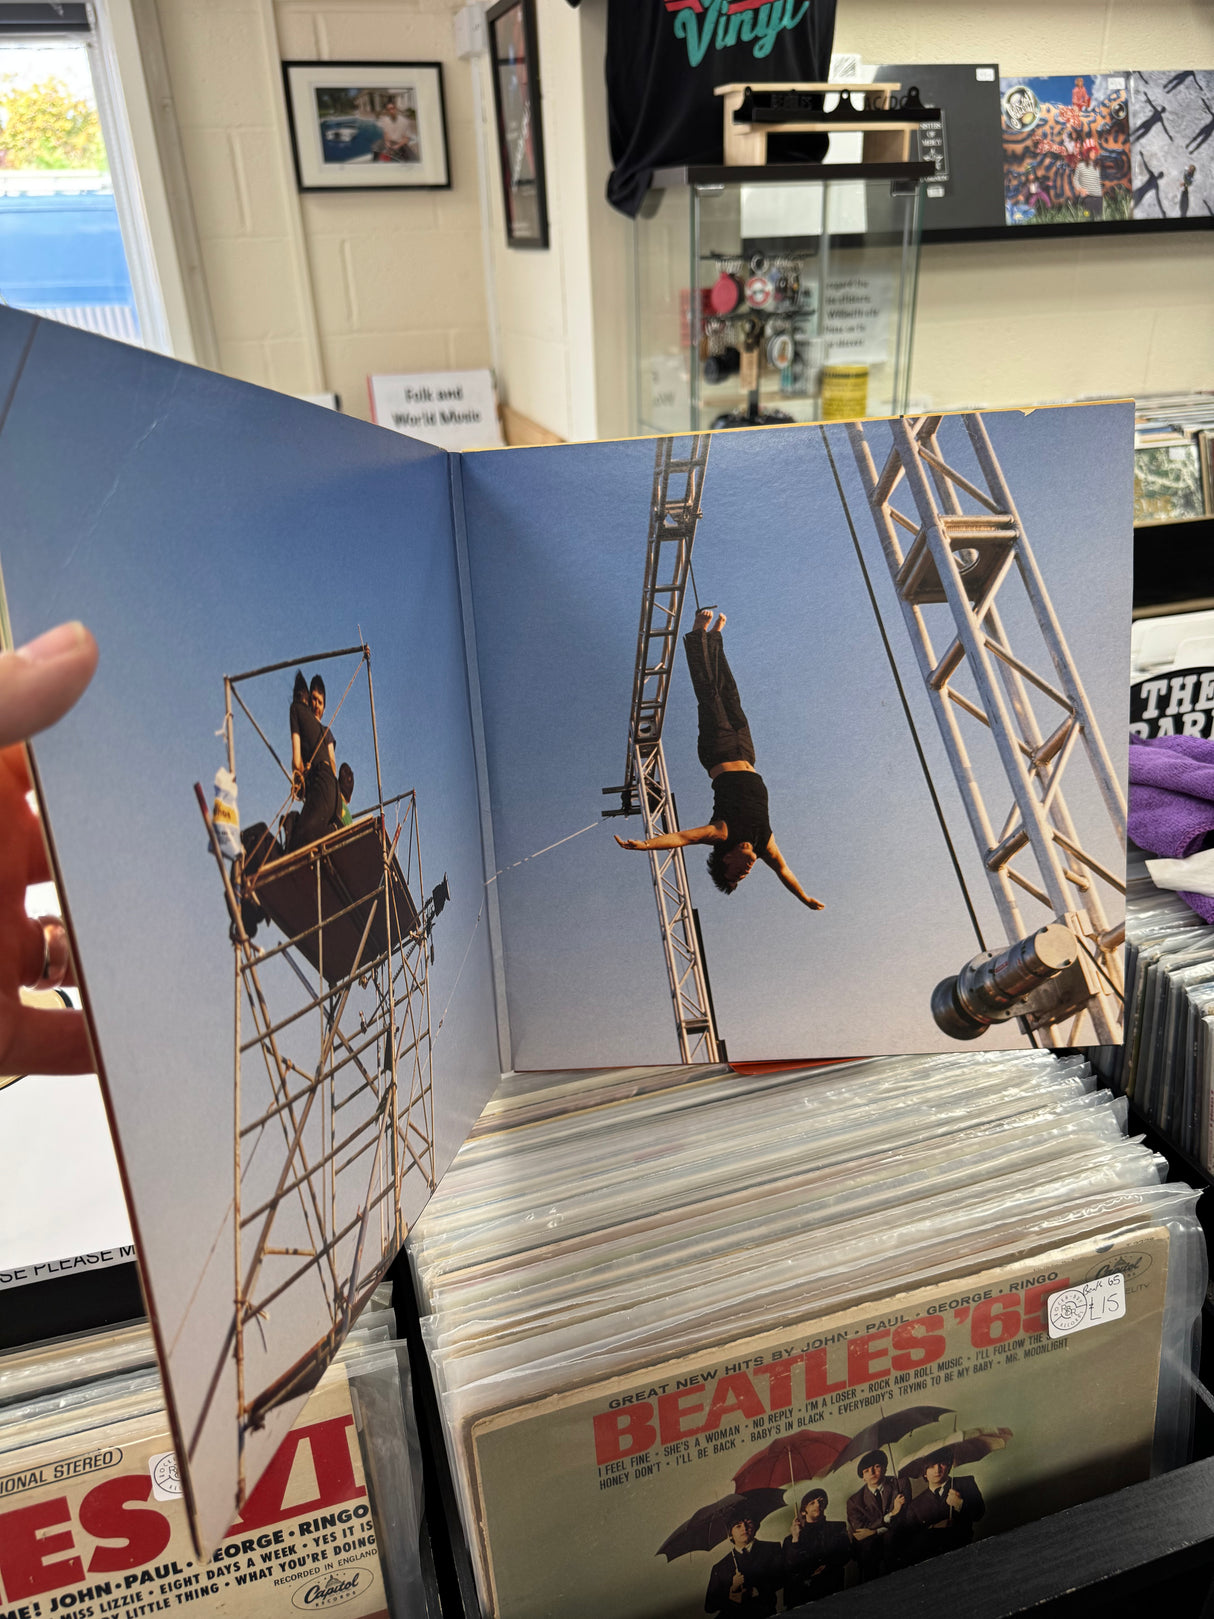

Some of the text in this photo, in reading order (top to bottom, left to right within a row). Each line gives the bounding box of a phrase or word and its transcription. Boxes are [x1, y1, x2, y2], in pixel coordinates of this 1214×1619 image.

[674, 0, 809, 67] Vinyl
[1141, 672, 1214, 719] THE
[0, 1270, 27, 1283] SE
[34, 1250, 114, 1276] PLEASE
[608, 1272, 1059, 1409] GREAT NEW HITS BY JOHN PAUL GEORGE RINGO
[592, 1314, 946, 1466] BEATLES
[599, 1338, 1069, 1490] HONEY DON'T I'LL BE BACK BABY'S IN BLACK EVERYBODY'S TRYING TO BE MY BABY MR. MOONLIGHT
[605, 1463, 627, 1476] FEEL
[630, 1452, 651, 1468] FINE
[663, 1441, 690, 1457] SHE'S
[694, 1437, 701, 1448] A
[705, 1424, 741, 1444] WOMAN
[752, 1417, 765, 1429] NO
[768, 1408, 794, 1424] REPLY
[805, 1400, 819, 1413] I'M
[821, 1397, 828, 1408] A
[830, 1389, 857, 1405] LOSER
[868, 1378, 891, 1394] ROCK
[894, 1372, 911, 1386] AND
[913, 1365, 935, 1379] ROLL
[937, 1356, 963, 1372] MUSIC
[975, 1350, 990, 1361] I'LL
[993, 1338, 1026, 1356] FOLLOW
[1028, 1333, 1043, 1346] THE
[0, 1450, 114, 1495] IONAL STEREO
[0, 1474, 171, 1605] ES
[0, 1504, 370, 1619] ME! JOHN PAUL EORGE RINGO
[60, 1606, 95, 1619] MISS
[100, 1591, 144, 1614] LIZZIE
[159, 1573, 201, 1595] EIGHT
[206, 1561, 241, 1580] DAYS
[246, 1557, 256, 1568] A
[260, 1544, 298, 1564] WEEK
[312, 1531, 337, 1548] YES
[342, 1526, 355, 1539] IT
[360, 1520, 374, 1532] IS
[126, 1597, 171, 1619] LITTLE
[175, 1581, 220, 1605] THING
[235, 1566, 274, 1586] WHAT
[279, 1547, 328, 1573] YOU'RE
[333, 1534, 376, 1556] DOING
[273, 1548, 378, 1587] RECORDED IN ENGLAND
[304, 1573, 360, 1605] Capitol
